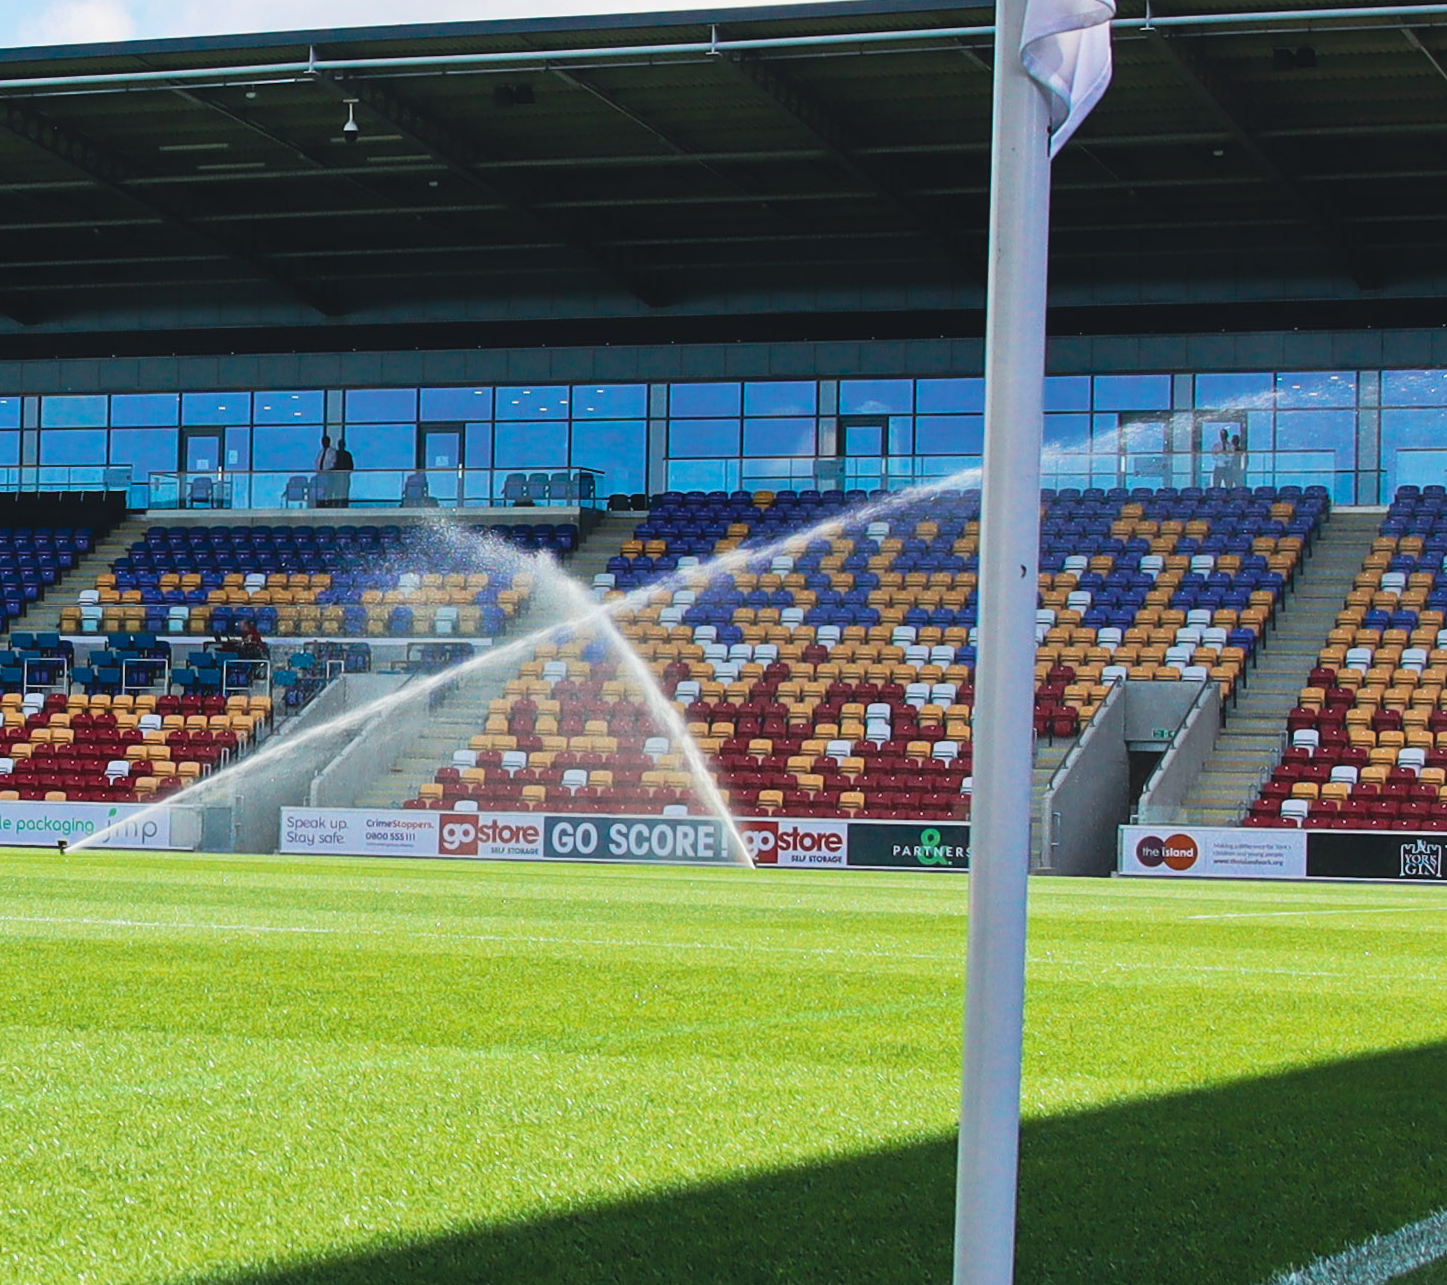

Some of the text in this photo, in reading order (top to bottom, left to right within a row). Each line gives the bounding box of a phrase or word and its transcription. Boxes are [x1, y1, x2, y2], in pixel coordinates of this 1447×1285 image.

[16, 814, 95, 835] packaging
[286, 816, 326, 830] Speak
[286, 831, 315, 846] Stay
[365, 832, 388, 840] 0800
[551, 822, 729, 858] GO SCORE!
[508, 847, 539, 855] STORAGE
[1142, 846, 1194, 858] the island
[809, 855, 843, 863] STORAGE
[1405, 854, 1437, 865] YORK
[1405, 864, 1437, 876] GIN
